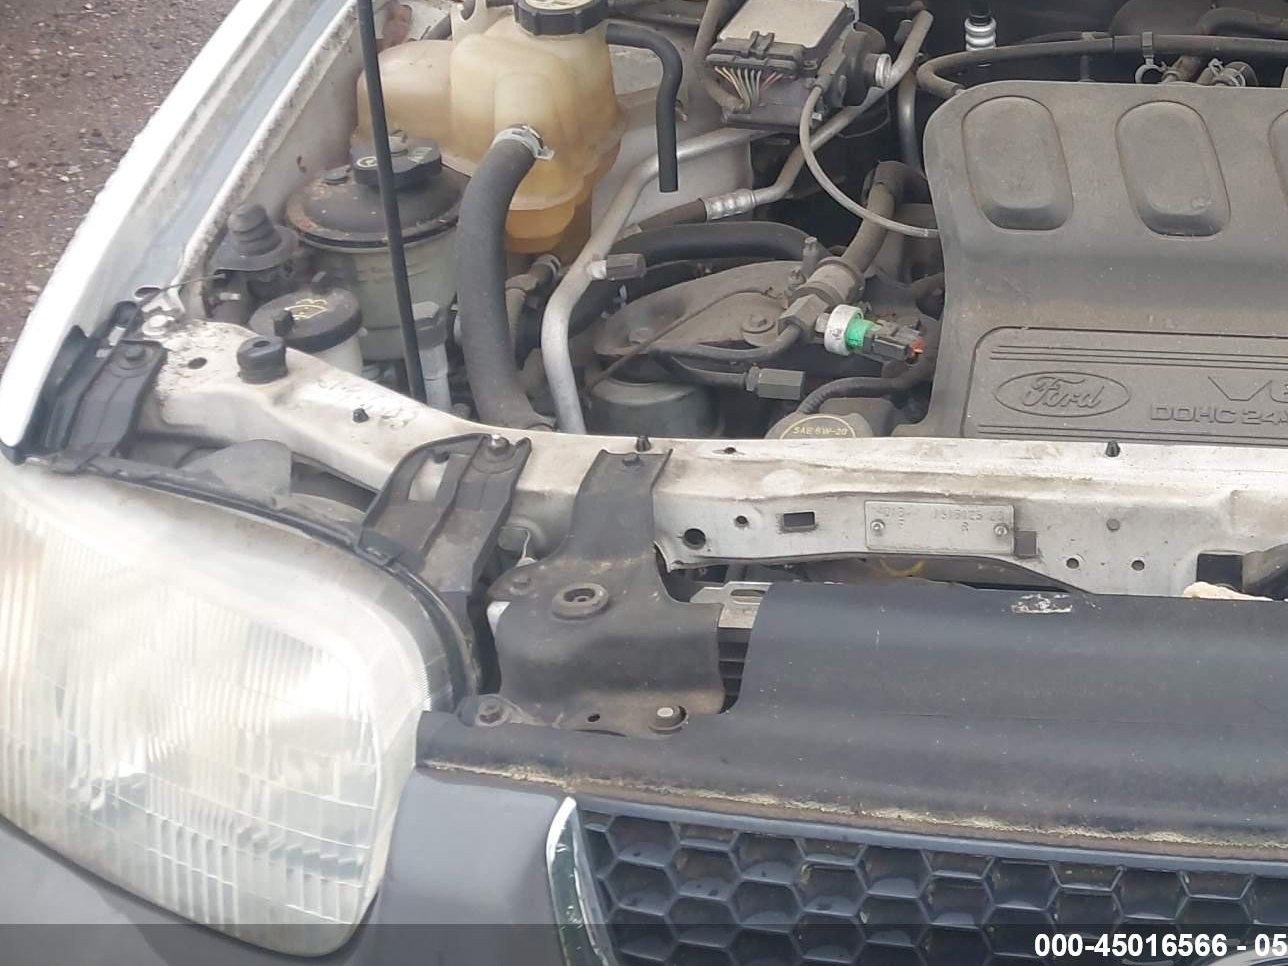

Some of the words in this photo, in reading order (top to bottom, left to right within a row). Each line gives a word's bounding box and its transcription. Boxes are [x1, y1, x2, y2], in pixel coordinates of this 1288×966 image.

[1022, 376, 1106, 409] Ford
[1149, 403, 1237, 424] DOHC
[792, 426, 814, 435] SAE
